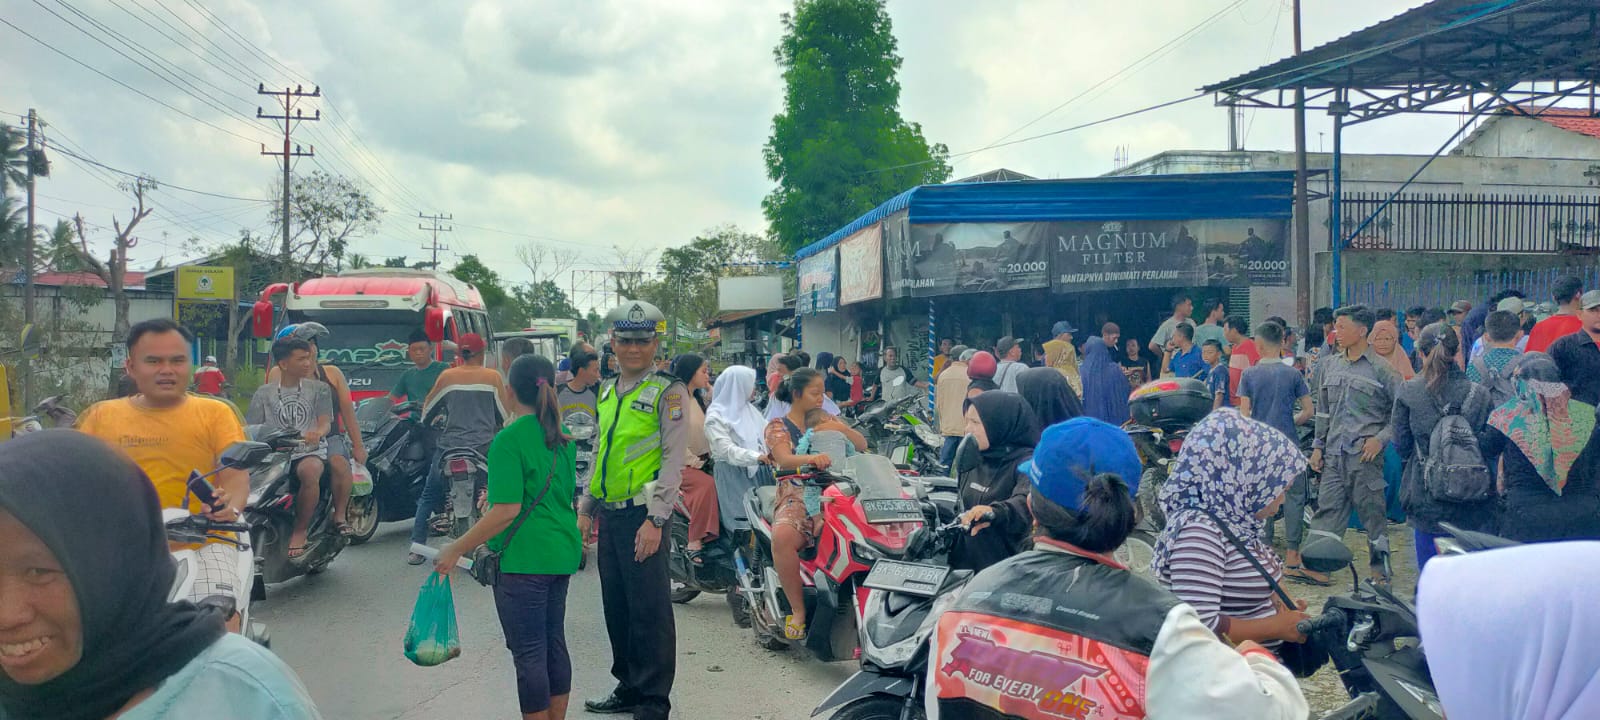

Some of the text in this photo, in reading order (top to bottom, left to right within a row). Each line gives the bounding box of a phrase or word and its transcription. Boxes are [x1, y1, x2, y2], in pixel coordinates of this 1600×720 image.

[1058, 232, 1168, 252] MAGNUM
[1082, 251, 1147, 266] FILTER
[1248, 260, 1287, 271] 20.000
[1061, 272, 1103, 284] MANTAPNYA
[1142, 269, 1179, 280] PERLAHAN
[969, 668, 1096, 720] FOR EVERY ONE
